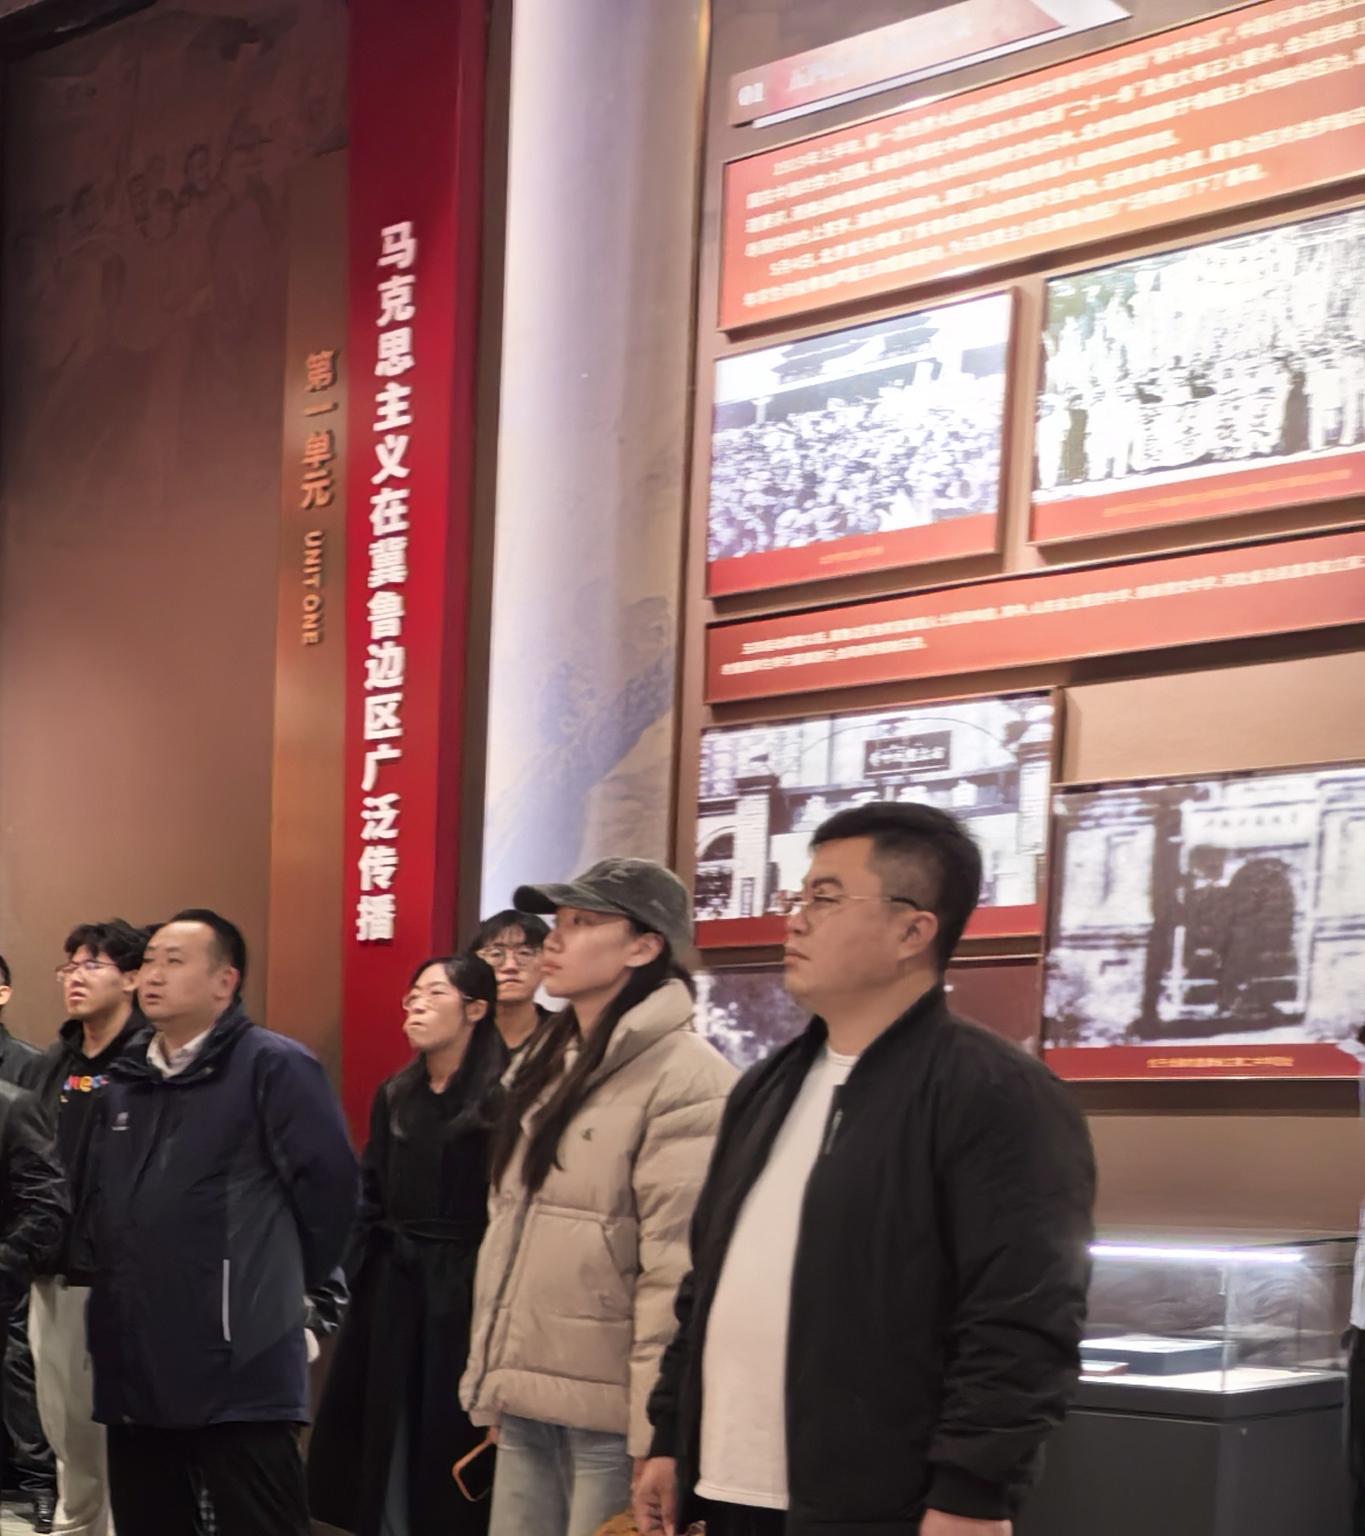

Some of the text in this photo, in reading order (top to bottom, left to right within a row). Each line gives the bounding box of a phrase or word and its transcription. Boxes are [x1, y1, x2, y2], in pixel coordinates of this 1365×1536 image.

[300, 350, 339, 645] 第一单元 UNIT ONE
[355, 221, 418, 942] 马克思主义在冀鲁边区广泛传播
